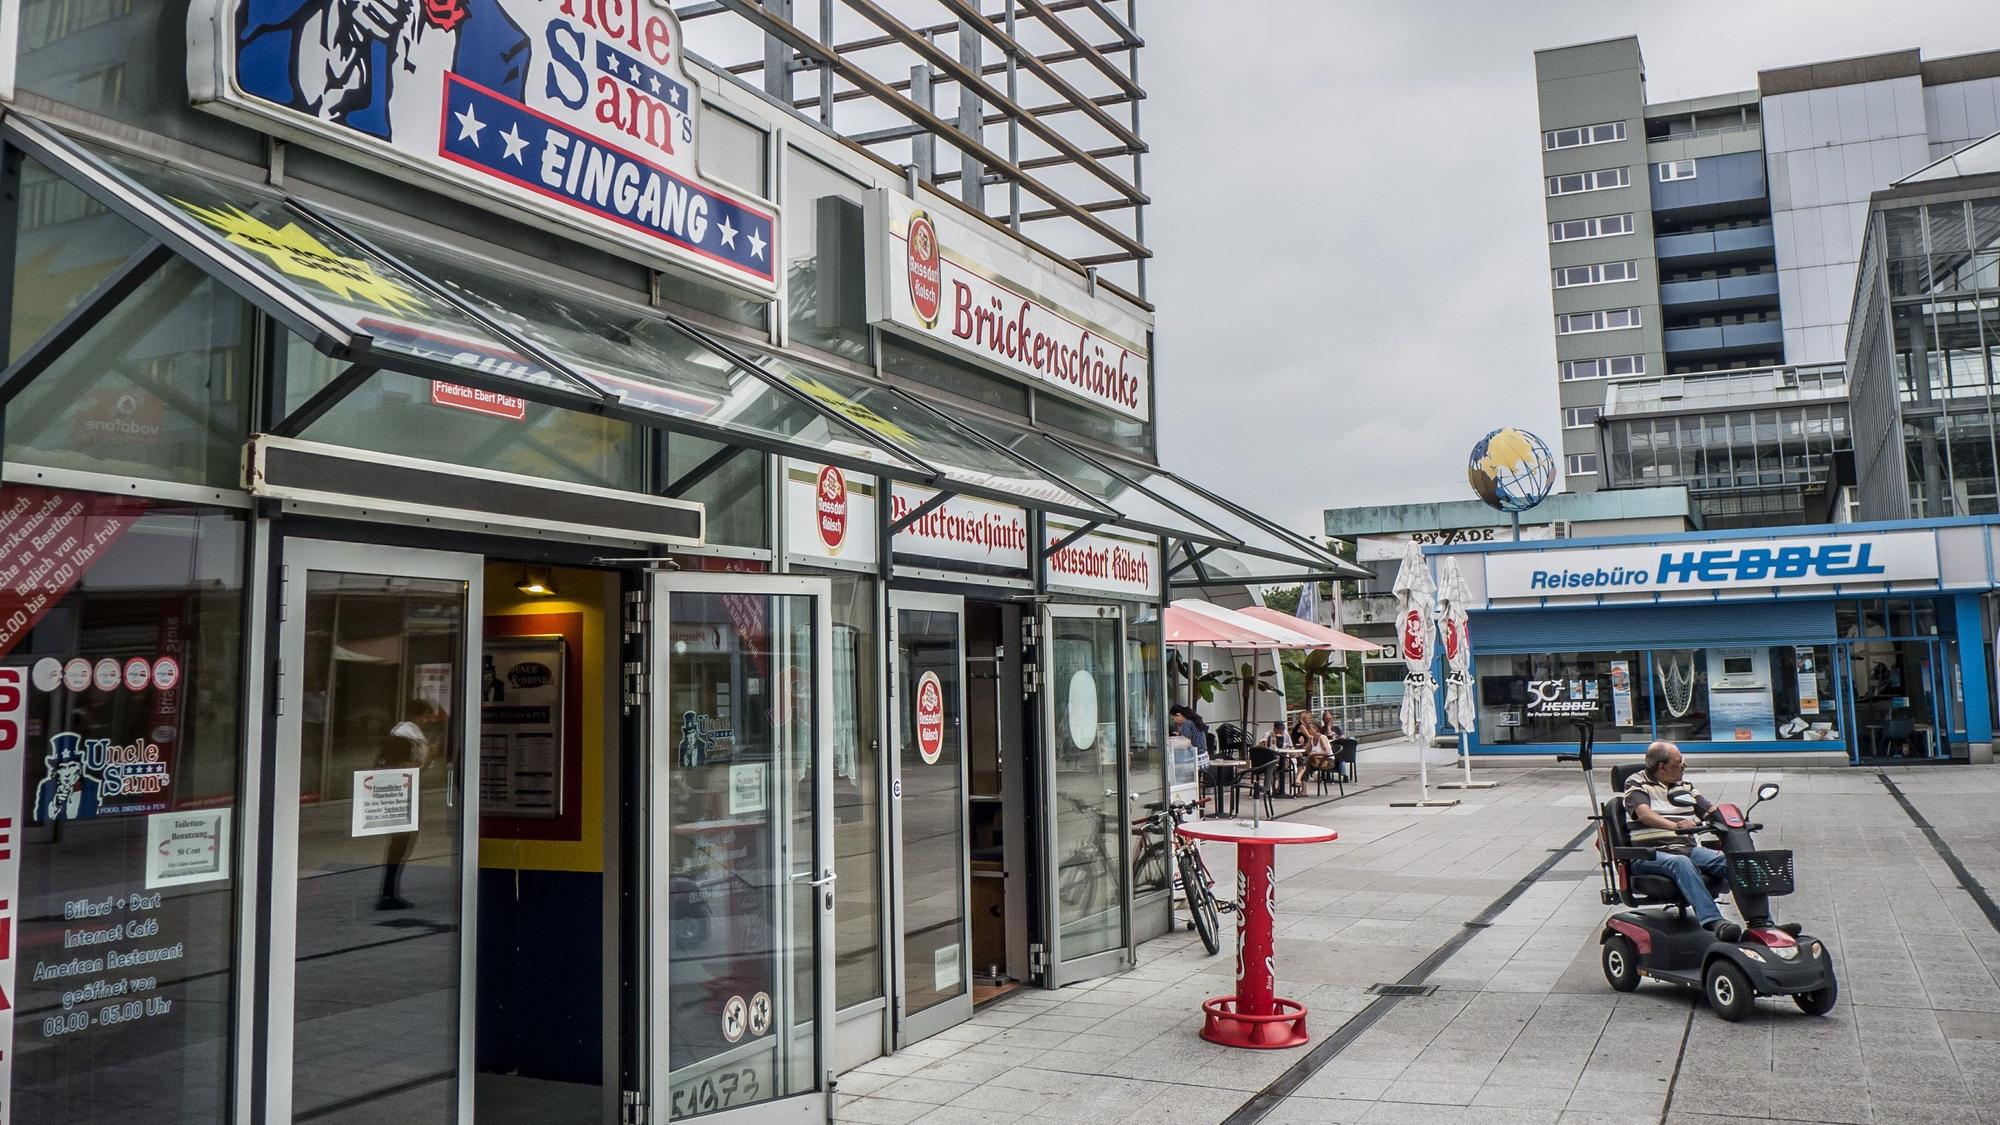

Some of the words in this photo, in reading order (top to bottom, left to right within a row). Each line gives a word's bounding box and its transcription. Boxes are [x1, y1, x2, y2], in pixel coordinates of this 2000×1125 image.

[559, 0, 671, 66] ncle
[541, 128, 709, 245] EINGANG
[952, 278, 1138, 410] Brückenschänke
[436, 380, 473, 399] Friedrich
[474, 389, 496, 404] Ebert
[496, 393, 516, 408] Platz
[517, 398, 523, 409] 9
[19, 550, 35, 567] in
[31, 501, 85, 553] Bestform
[15, 557, 56, 597] täglich
[54, 535, 78, 558] von
[24, 592, 47, 615] bis
[43, 562, 75, 595] 5.00
[71, 543, 96, 567] Uhr
[94, 517, 122, 546] früh
[1111, 545, 1150, 592] Kölsch
[1531, 567, 1649, 590] Reisebüro
[1656, 543, 1886, 585] HEBBEL
[1541, 701, 1600, 711] HEBBEL
[84, 737, 159, 771] Uncle
[100, 805, 120, 814] FOOD,
[121, 804, 146, 813] DRINKS
[185, 847, 201, 856] Cent
[64, 895, 113, 920] Billard
[130, 893, 161, 911] Dart
[64, 924, 123, 949] Internet
[125, 918, 160, 939] Café
[33, 957, 103, 982] American
[107, 942, 184, 970] Restaurant
[63, 979, 129, 1010] geöffnet
[130, 976, 157, 992] von
[43, 1011, 90, 1038] 08.00
[100, 1000, 144, 1026] 05.00
[145, 996, 173, 1017] Uhr
